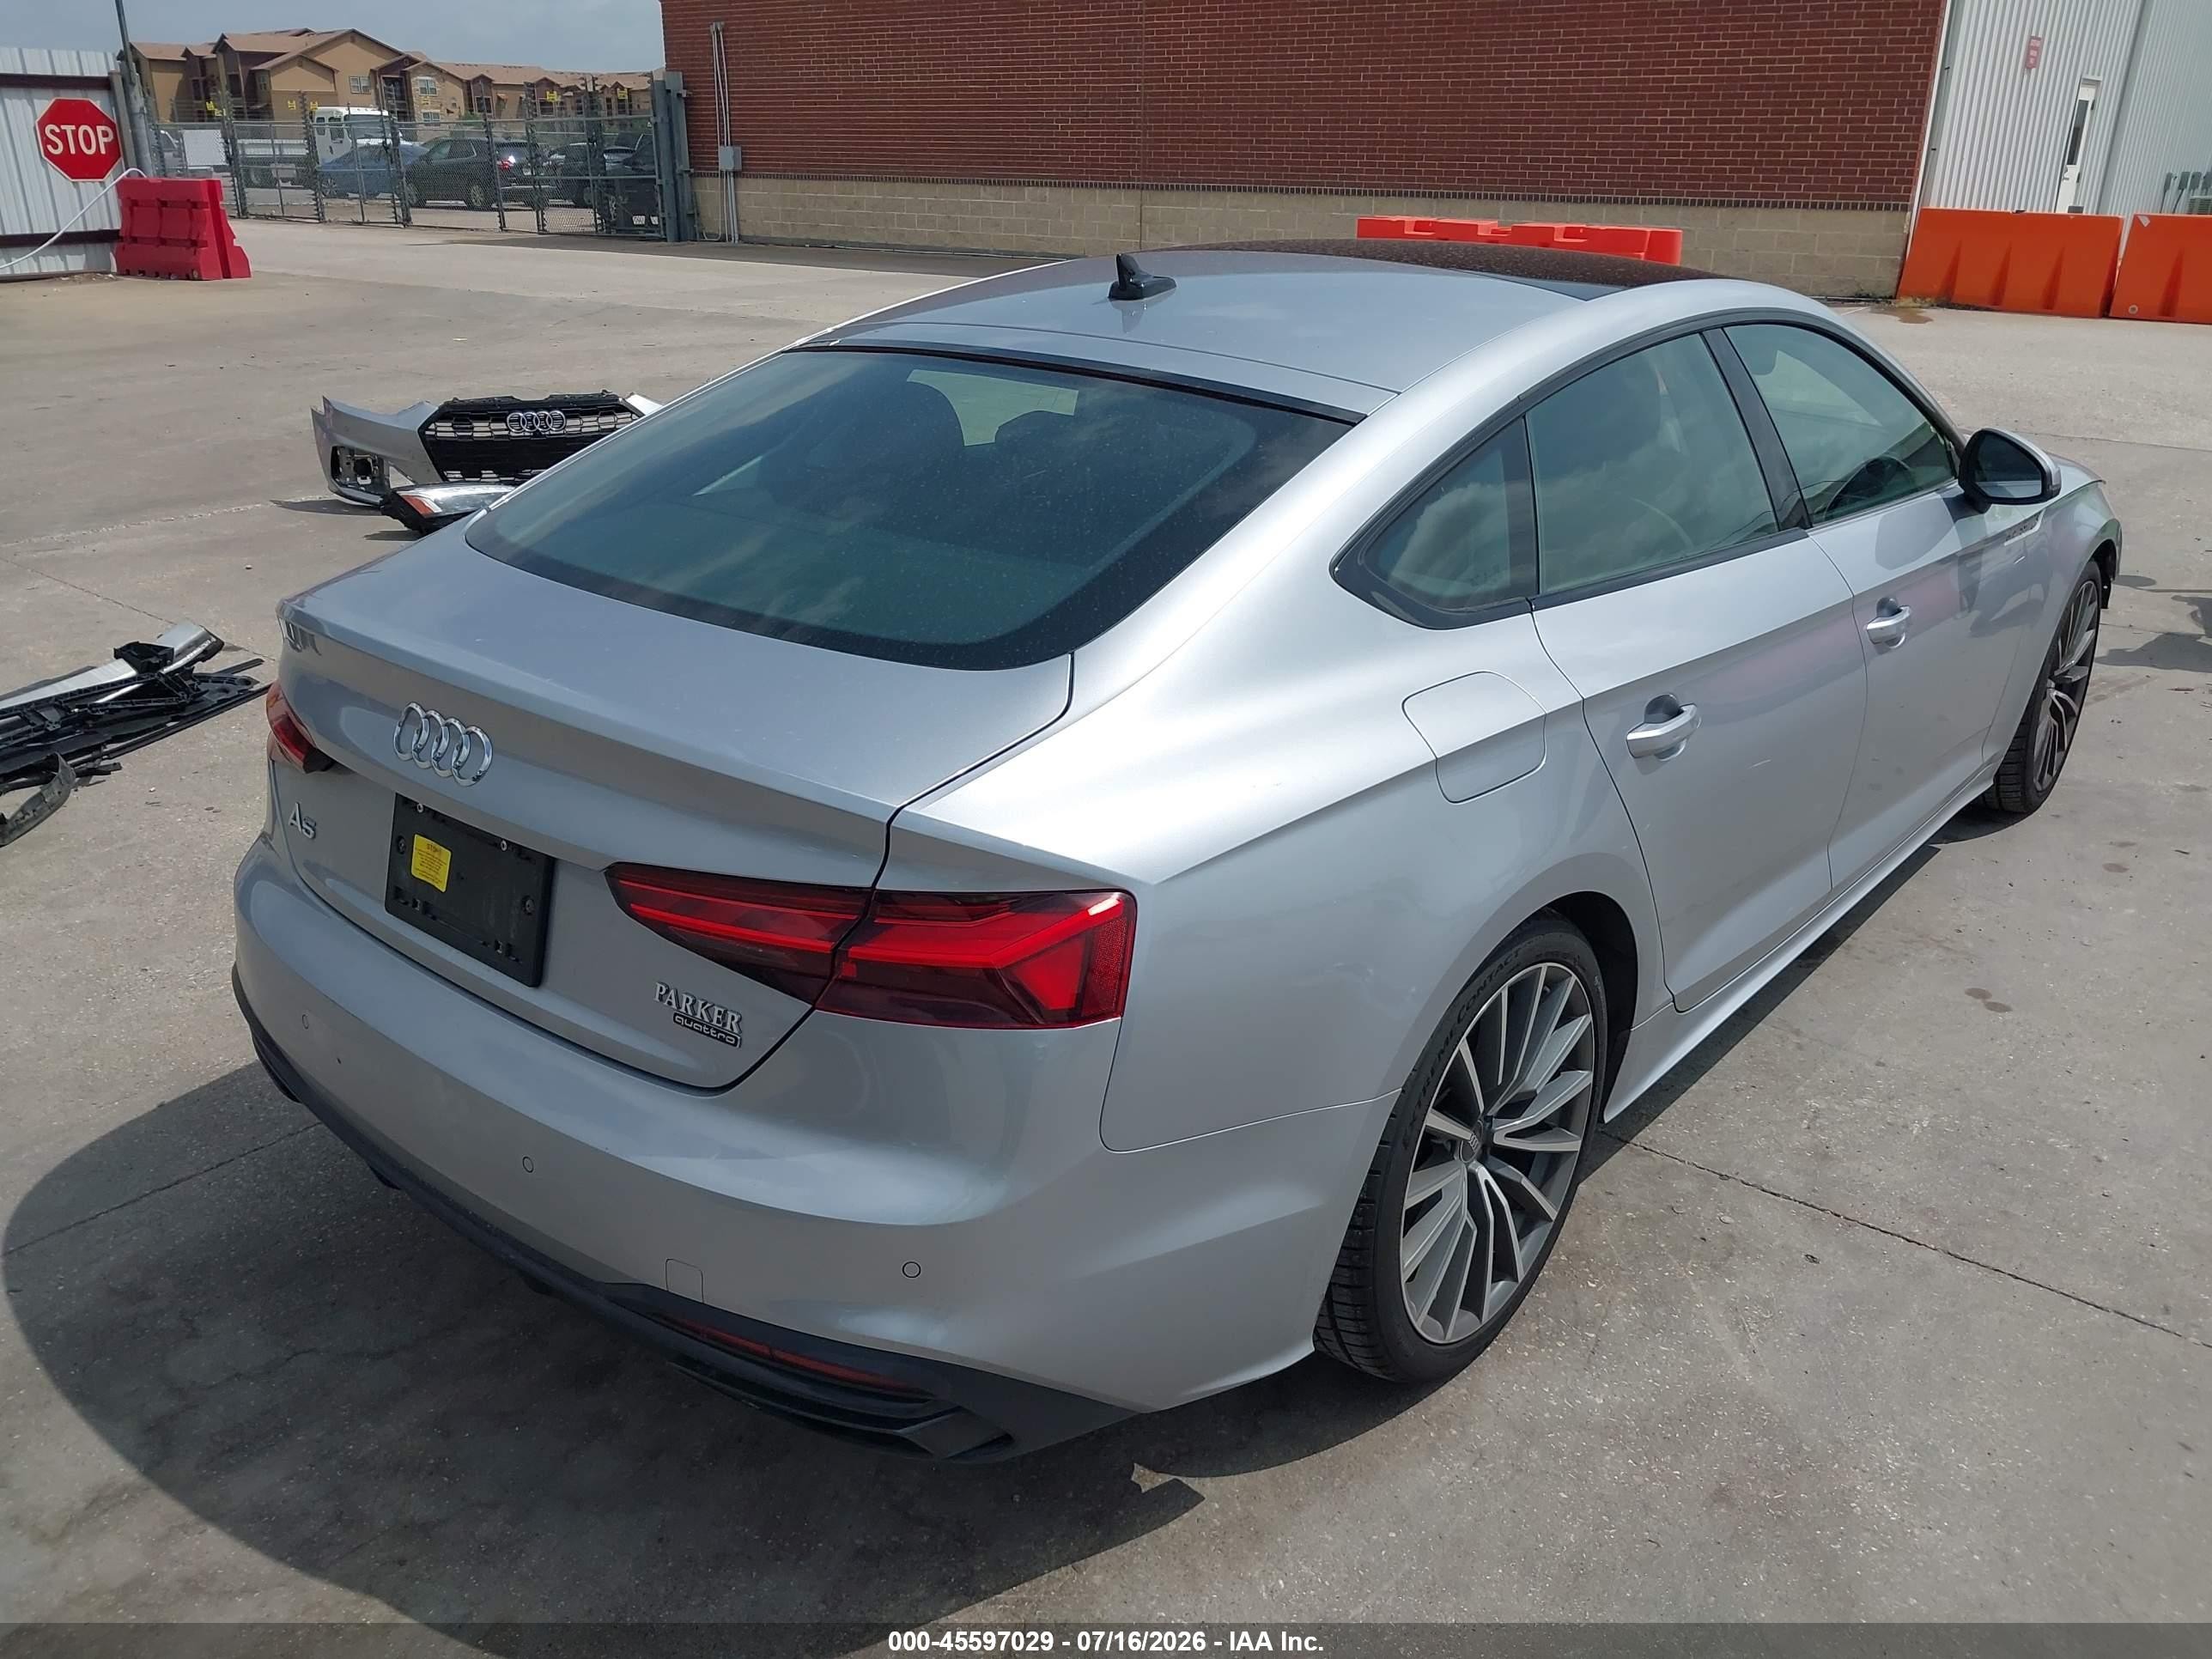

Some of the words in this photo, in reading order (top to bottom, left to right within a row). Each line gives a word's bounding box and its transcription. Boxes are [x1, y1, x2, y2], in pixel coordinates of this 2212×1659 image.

[44, 125, 114, 155] STOP
[288, 802, 316, 839] A5
[653, 981, 743, 1035] PARKER
[674, 1015, 736, 1044] quattro
